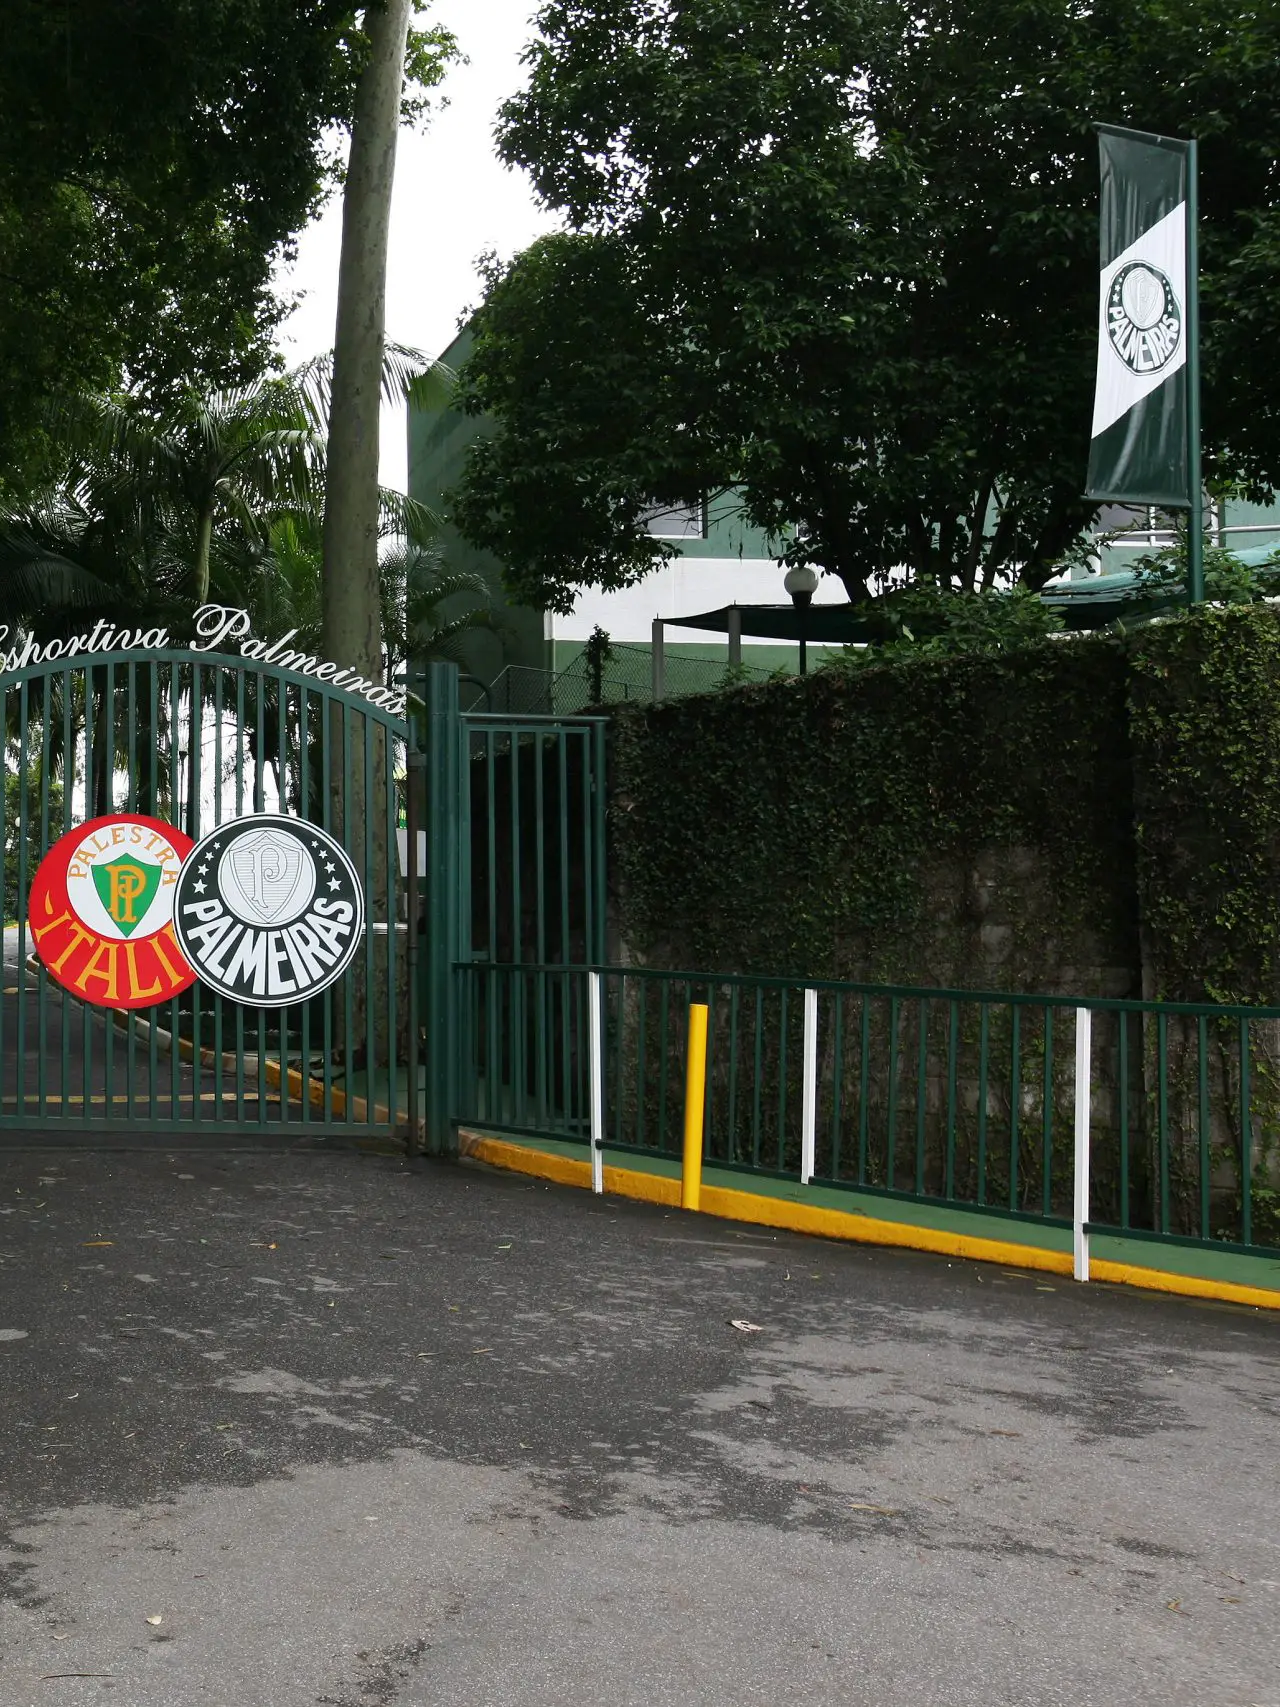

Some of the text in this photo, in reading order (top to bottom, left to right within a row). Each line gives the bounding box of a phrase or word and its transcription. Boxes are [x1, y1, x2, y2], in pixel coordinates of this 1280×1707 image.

[1109, 306, 1179, 370] PALMEIRAS
[190, 603, 406, 714] Palmeiras
[68, 826, 179, 886] PALESTRA
[183, 897, 354, 995] PALMEIRAS
